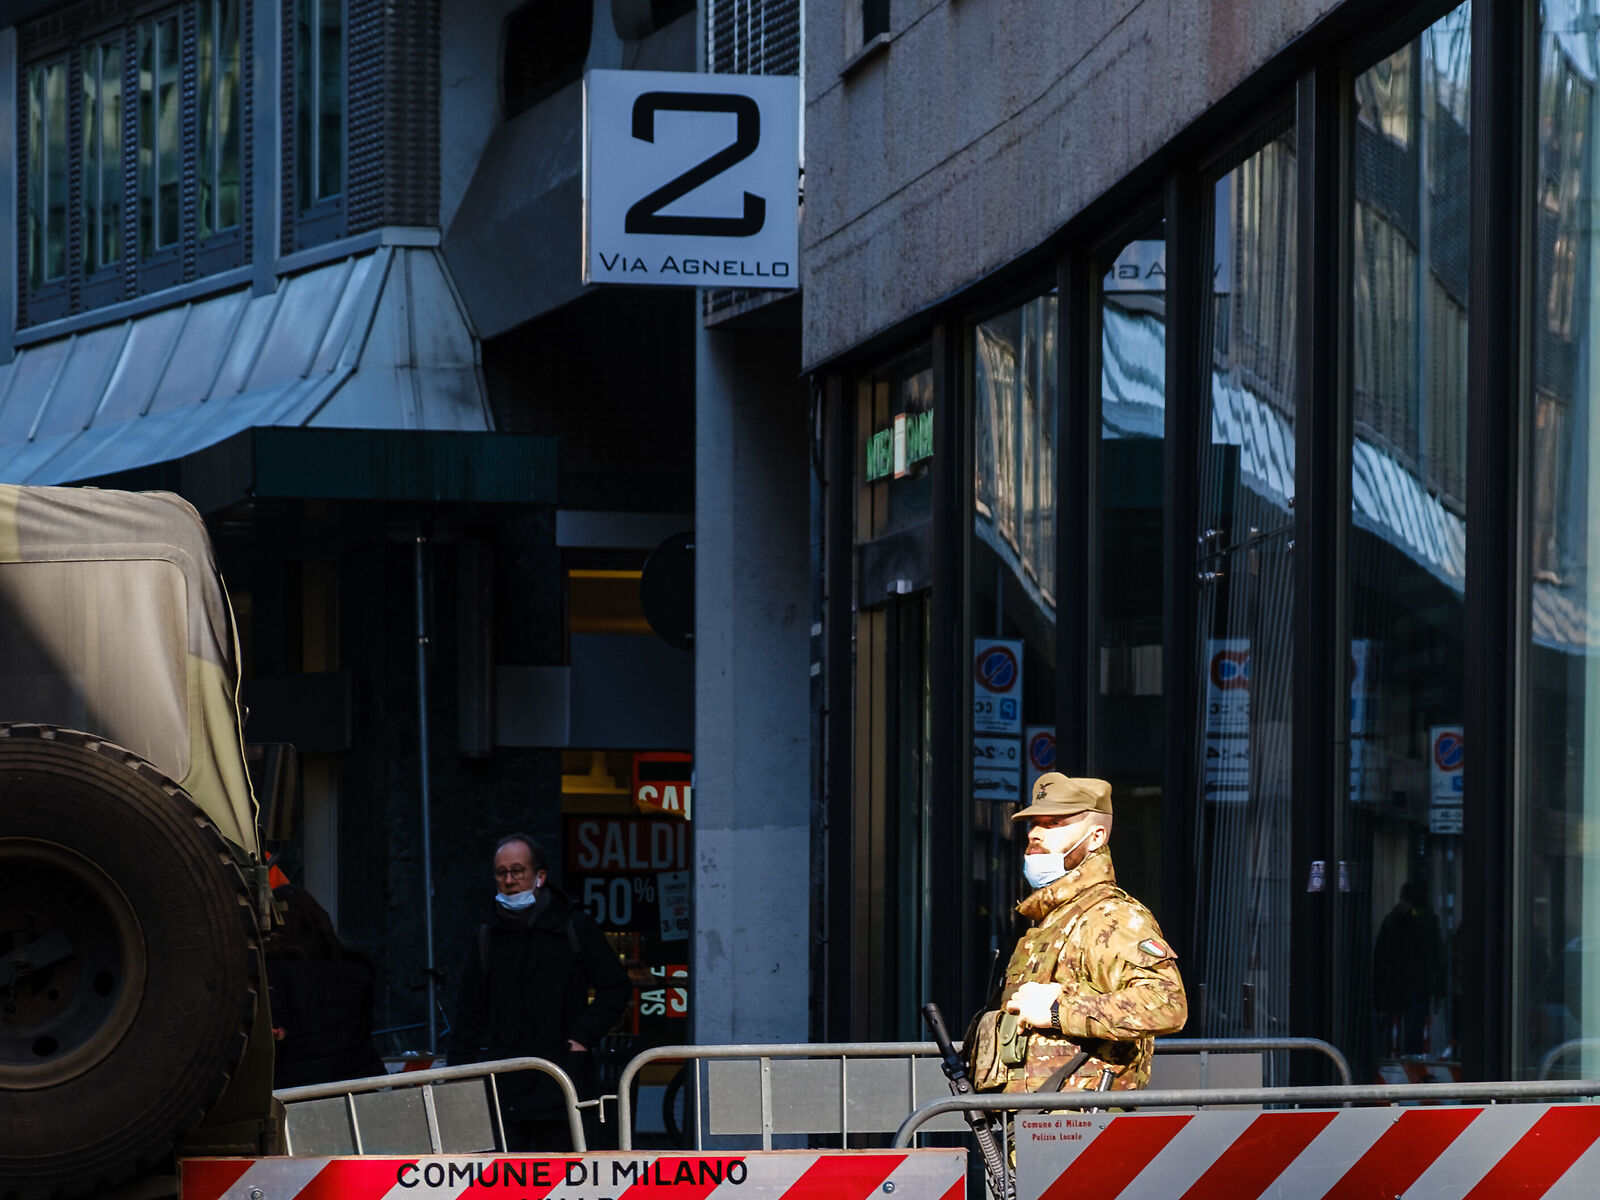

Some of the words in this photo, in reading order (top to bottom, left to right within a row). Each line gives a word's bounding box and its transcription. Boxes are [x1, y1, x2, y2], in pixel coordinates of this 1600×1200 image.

[624, 91, 766, 237] 2
[599, 252, 647, 273] VIA
[660, 255, 789, 277] AGNELLO
[577, 821, 686, 869] SALDI
[1022, 1120, 1052, 1129] Comune
[1055, 1119, 1062, 1128] di
[1066, 1119, 1092, 1128] Milano
[1032, 1133, 1056, 1141] Polizia
[396, 1161, 552, 1188] COMUNE
[566, 1160, 599, 1186] DI
[612, 1159, 748, 1187] MILANO
